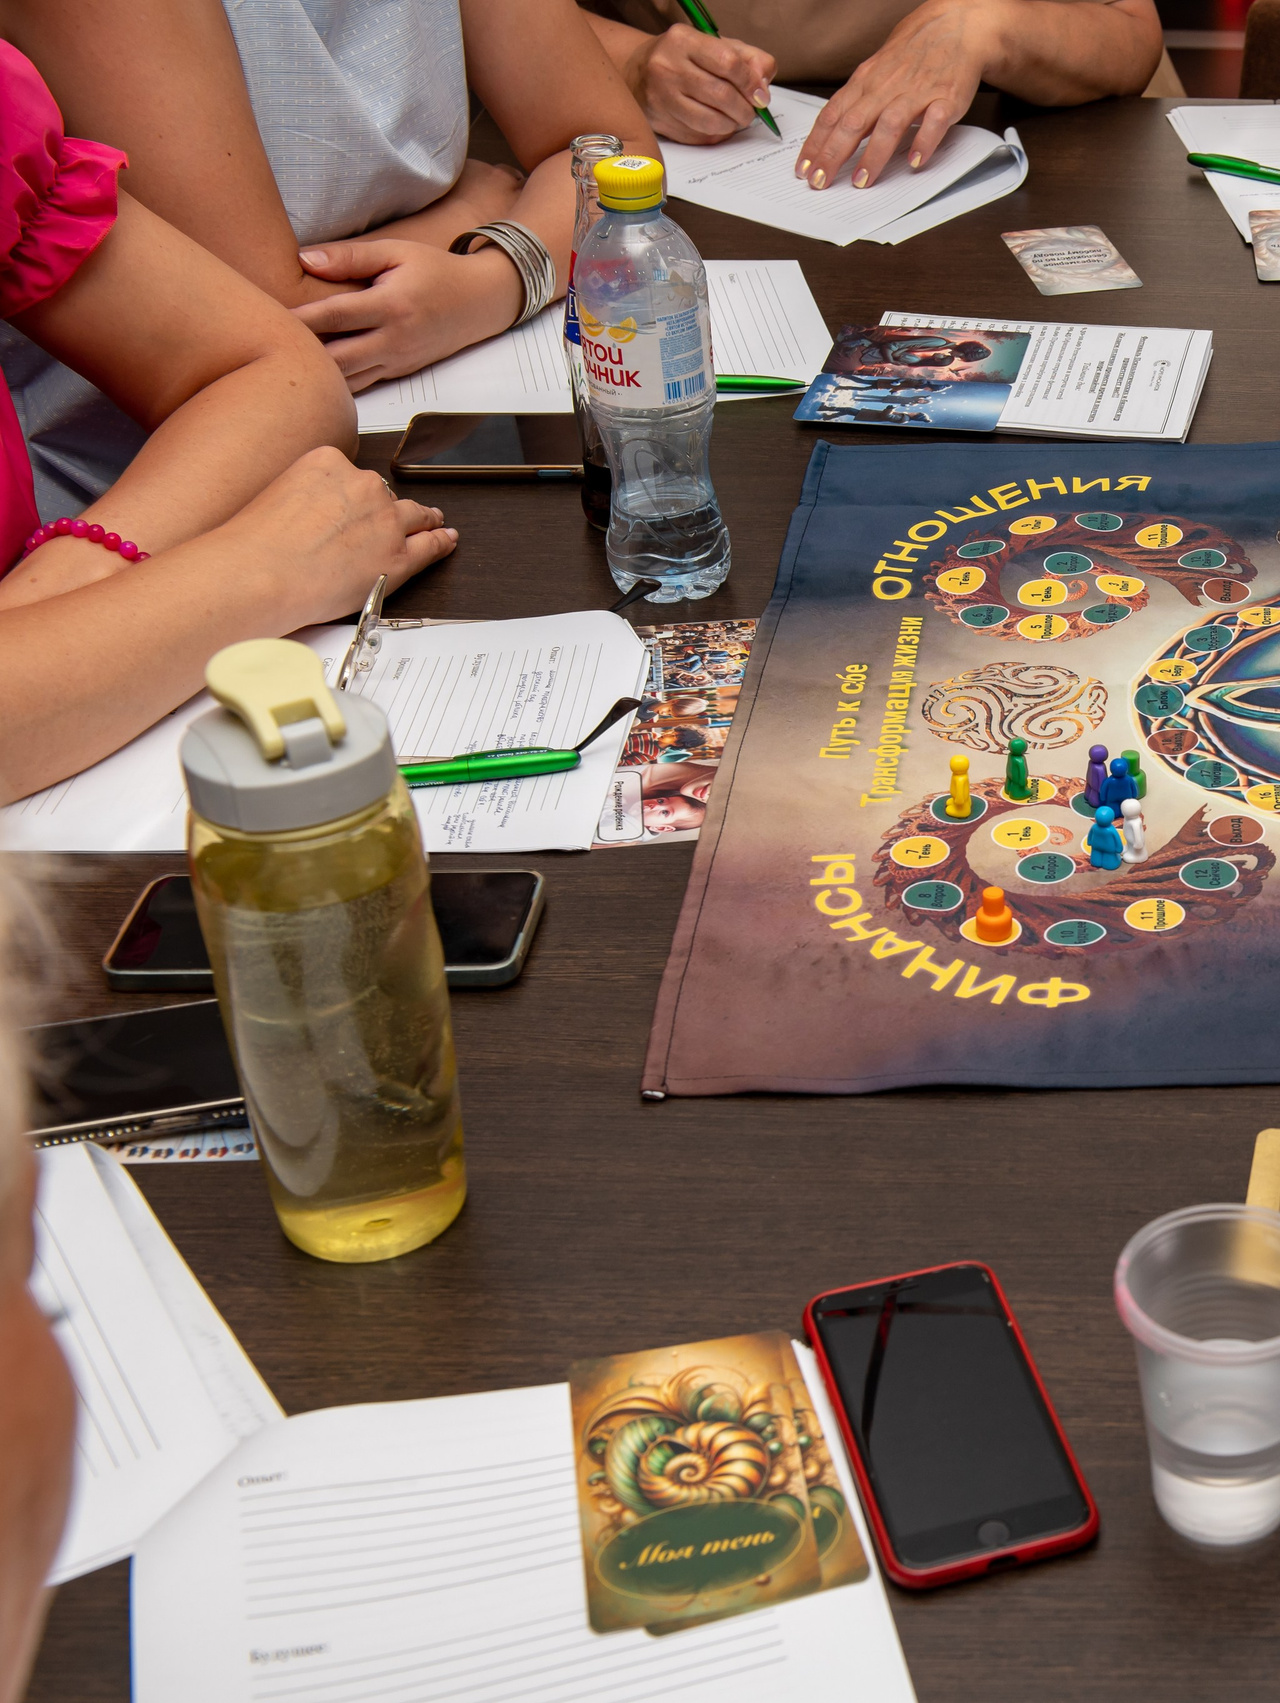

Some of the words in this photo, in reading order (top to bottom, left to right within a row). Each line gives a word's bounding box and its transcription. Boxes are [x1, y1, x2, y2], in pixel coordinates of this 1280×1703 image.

[872, 475, 1152, 601] ОТНОШЕНИЯ
[1158, 524, 1169, 547] Прошлое
[959, 571, 970, 585] Тень
[1042, 586, 1053, 602] Тень
[1221, 580, 1231, 600] Выход
[1041, 615, 1053, 639] Прошлое
[893, 616, 923, 667] жизни
[1172, 665, 1183, 677] Беру
[836, 700, 861, 712] к
[1159, 691, 1168, 710] Блок
[818, 718, 861, 759] Путь
[1211, 762, 1222, 786] Помощь
[613, 781, 624, 807] Рождение
[613, 808, 625, 831] ребенка
[1230, 818, 1243, 842] Выход
[1020, 826, 1032, 841] Тень
[919, 844, 931, 859] Тень
[1044, 856, 1058, 879] Вопрос
[1210, 862, 1221, 885] Сейчас
[931, 885, 944, 907] Вопрос
[1154, 900, 1167, 930] Прошлое
[809, 852, 1091, 1009] ФИНАНСЫ
[619, 1540, 694, 1570] Моя
[700, 1530, 775, 1557] тень
